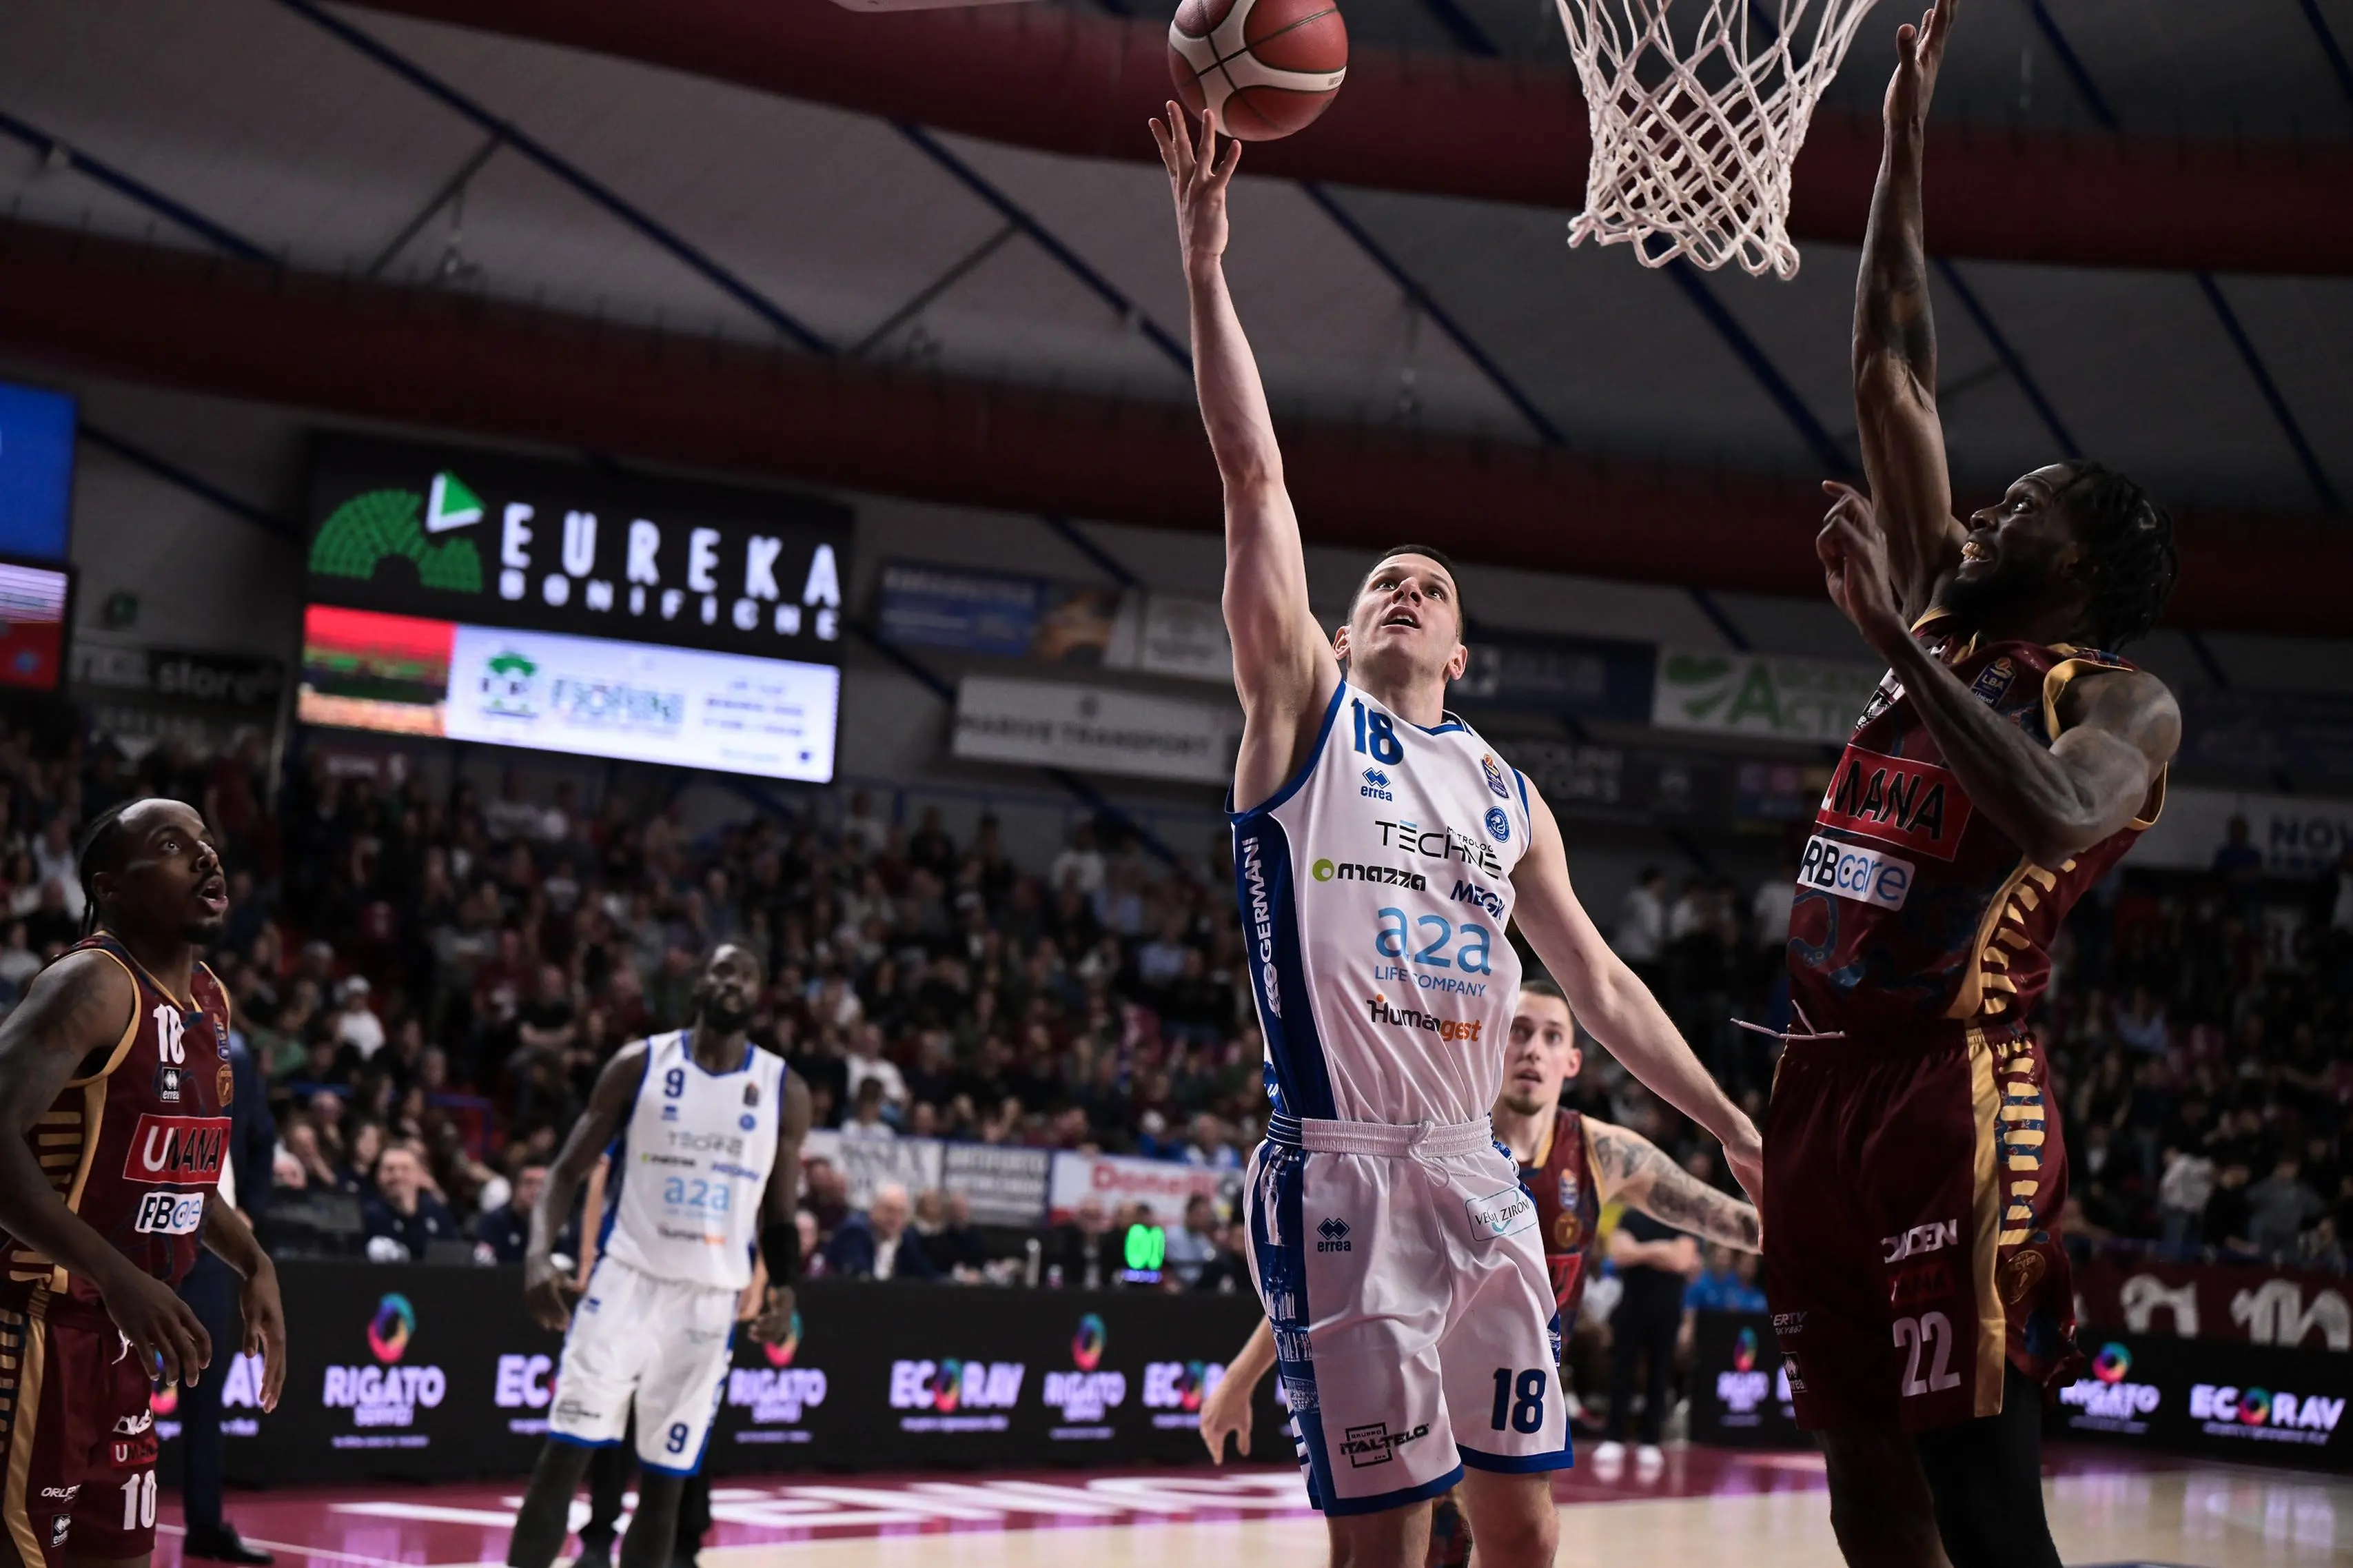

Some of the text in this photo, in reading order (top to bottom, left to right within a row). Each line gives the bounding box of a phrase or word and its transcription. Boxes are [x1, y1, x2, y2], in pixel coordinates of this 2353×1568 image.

[501, 501, 842, 607] EUREKA
[498, 568, 840, 641] BONIFICHE
[1981, 674, 2004, 690] LBA
[1351, 698, 1404, 766] 18
[1360, 785, 1392, 802] errea
[1824, 760, 1946, 840] MANA
[1338, 862, 1427, 892] mazza
[1374, 906, 1492, 976] a2a
[1374, 966, 1407, 981] LIFE
[1366, 994, 1482, 1042] Humangest
[664, 1068, 685, 1098] 9
[664, 1177, 730, 1211] a2a
[1317, 1239, 1351, 1252] errea
[1892, 1311, 1961, 1397] 22
[323, 1365, 447, 1409] RIGATO
[728, 1367, 827, 1408] RIGATO
[1490, 1367, 1546, 1434] 18
[2189, 1383, 2346, 1432] ECORAV
[666, 1421, 688, 1454] 9
[120, 1469, 157, 1530] 10
